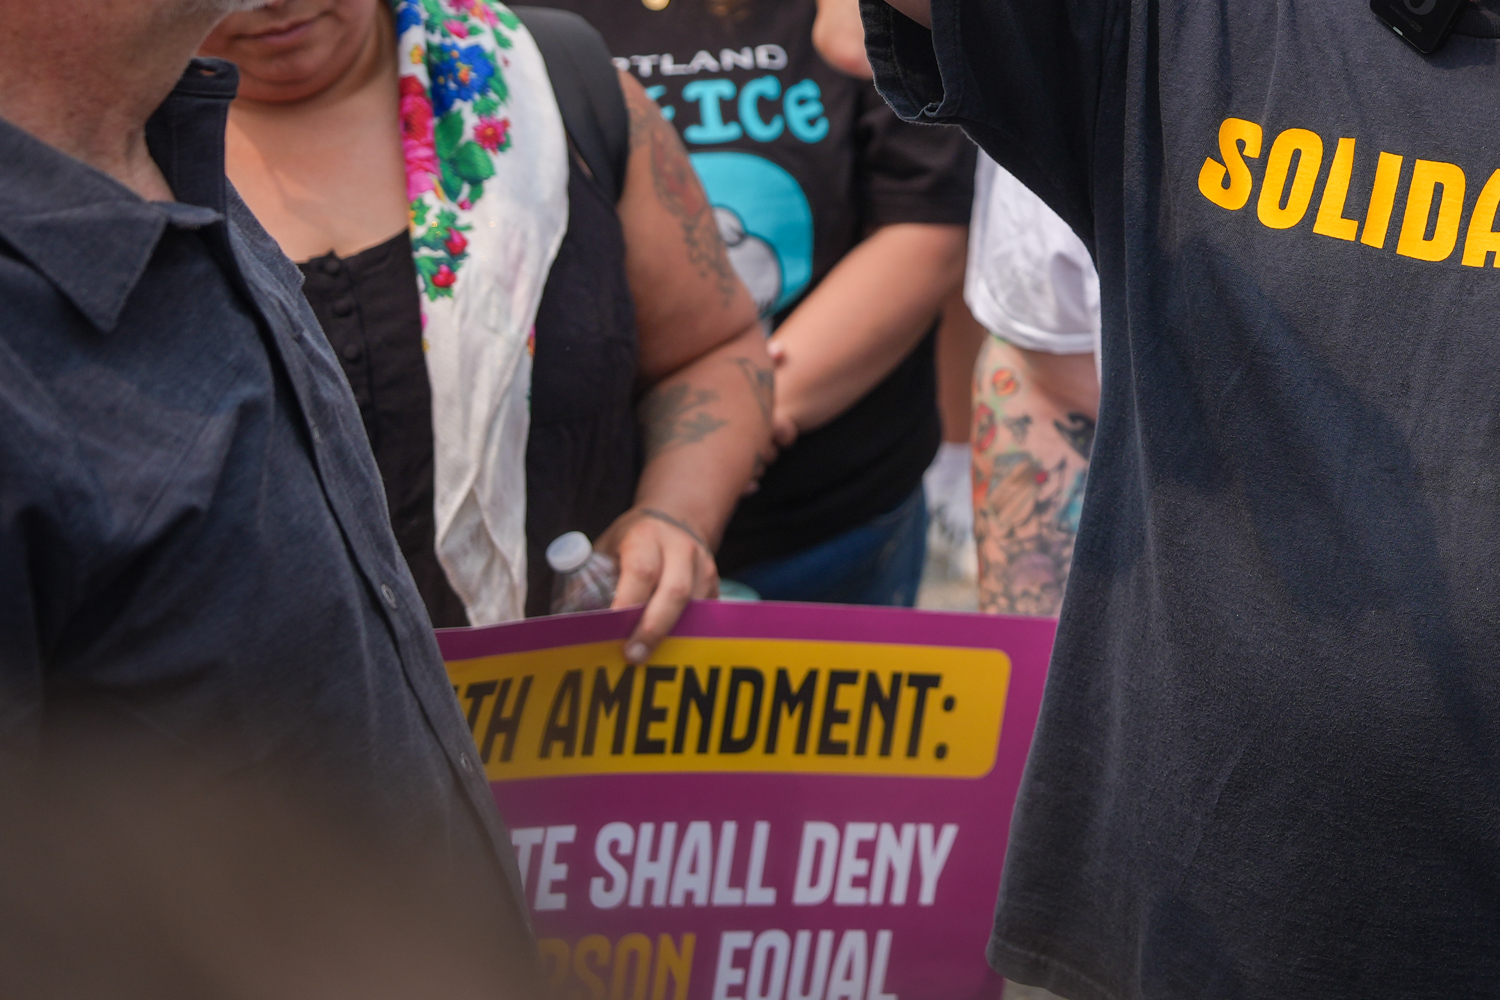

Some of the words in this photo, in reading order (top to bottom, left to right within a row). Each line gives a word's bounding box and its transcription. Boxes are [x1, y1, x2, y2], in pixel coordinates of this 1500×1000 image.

[449, 674, 535, 765] TH
[537, 664, 957, 762] AMENDMENT:
[589, 821, 778, 910] SHALL
[791, 821, 959, 908] DENY
[711, 928, 898, 1000] EQUAL
